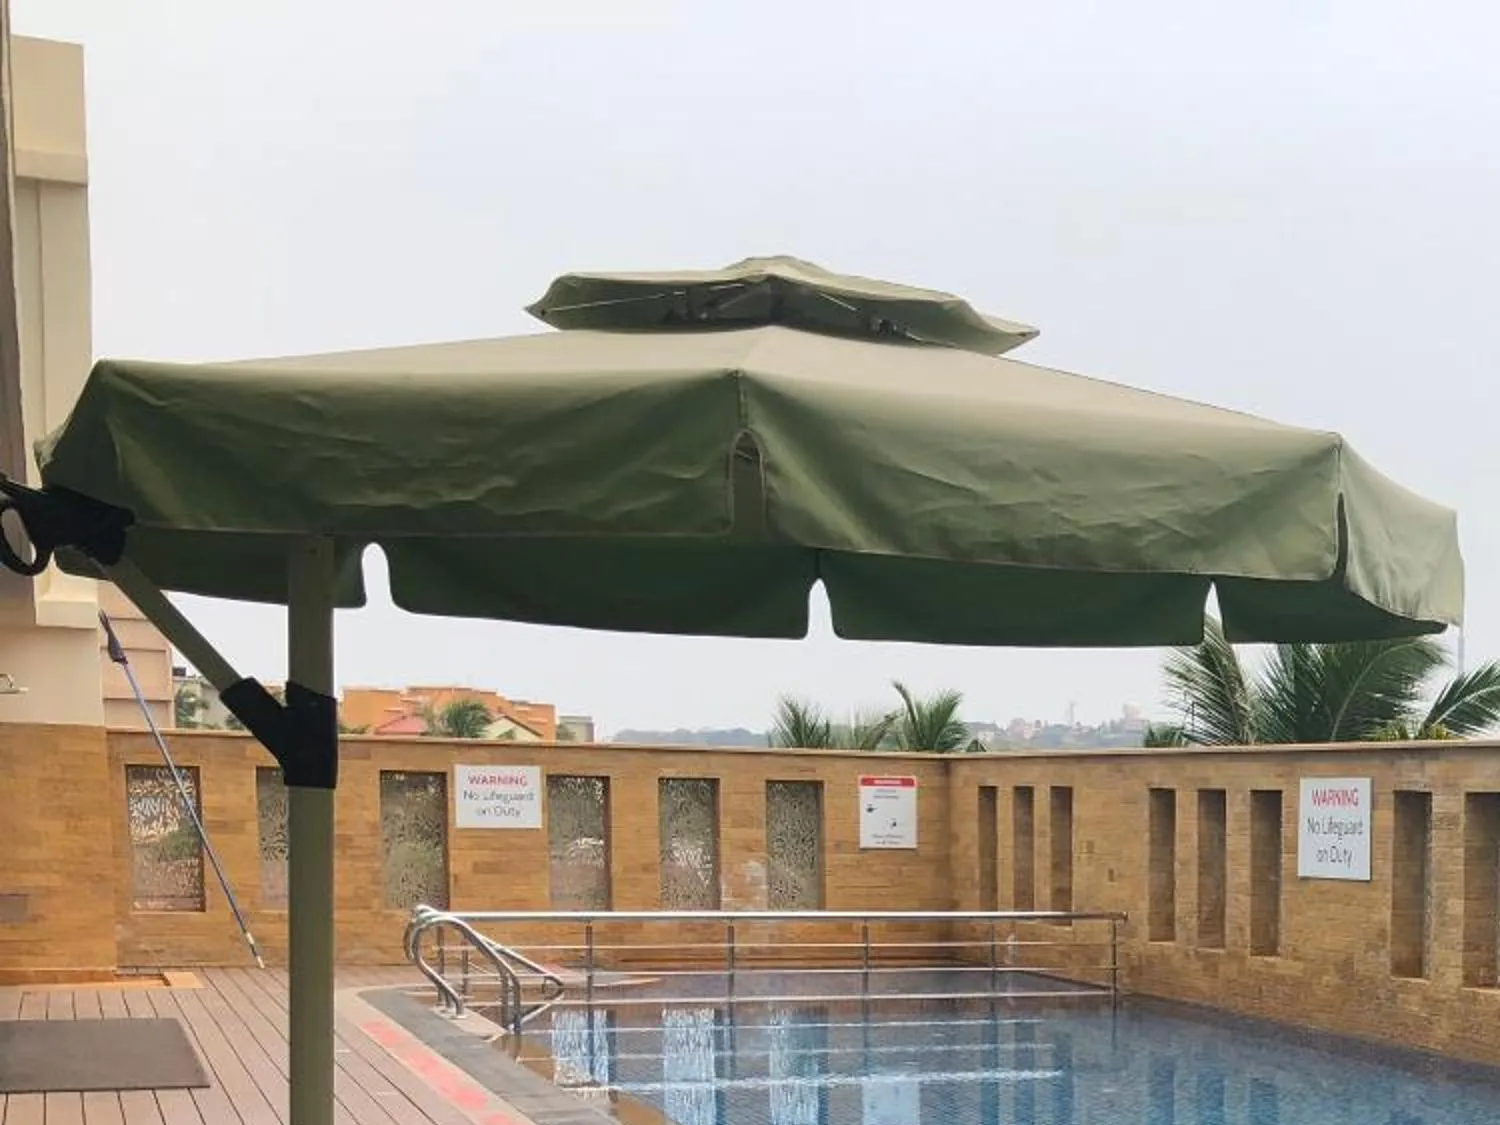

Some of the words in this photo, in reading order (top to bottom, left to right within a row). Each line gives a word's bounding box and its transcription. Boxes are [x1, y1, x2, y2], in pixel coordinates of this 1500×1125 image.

[468, 774, 528, 786] WARNING
[463, 789, 480, 801] No
[1311, 787, 1359, 807] WARNING
[1306, 816, 1320, 834] No
[1321, 816, 1364, 841] Lifeguard
[1316, 848, 1328, 863] on
